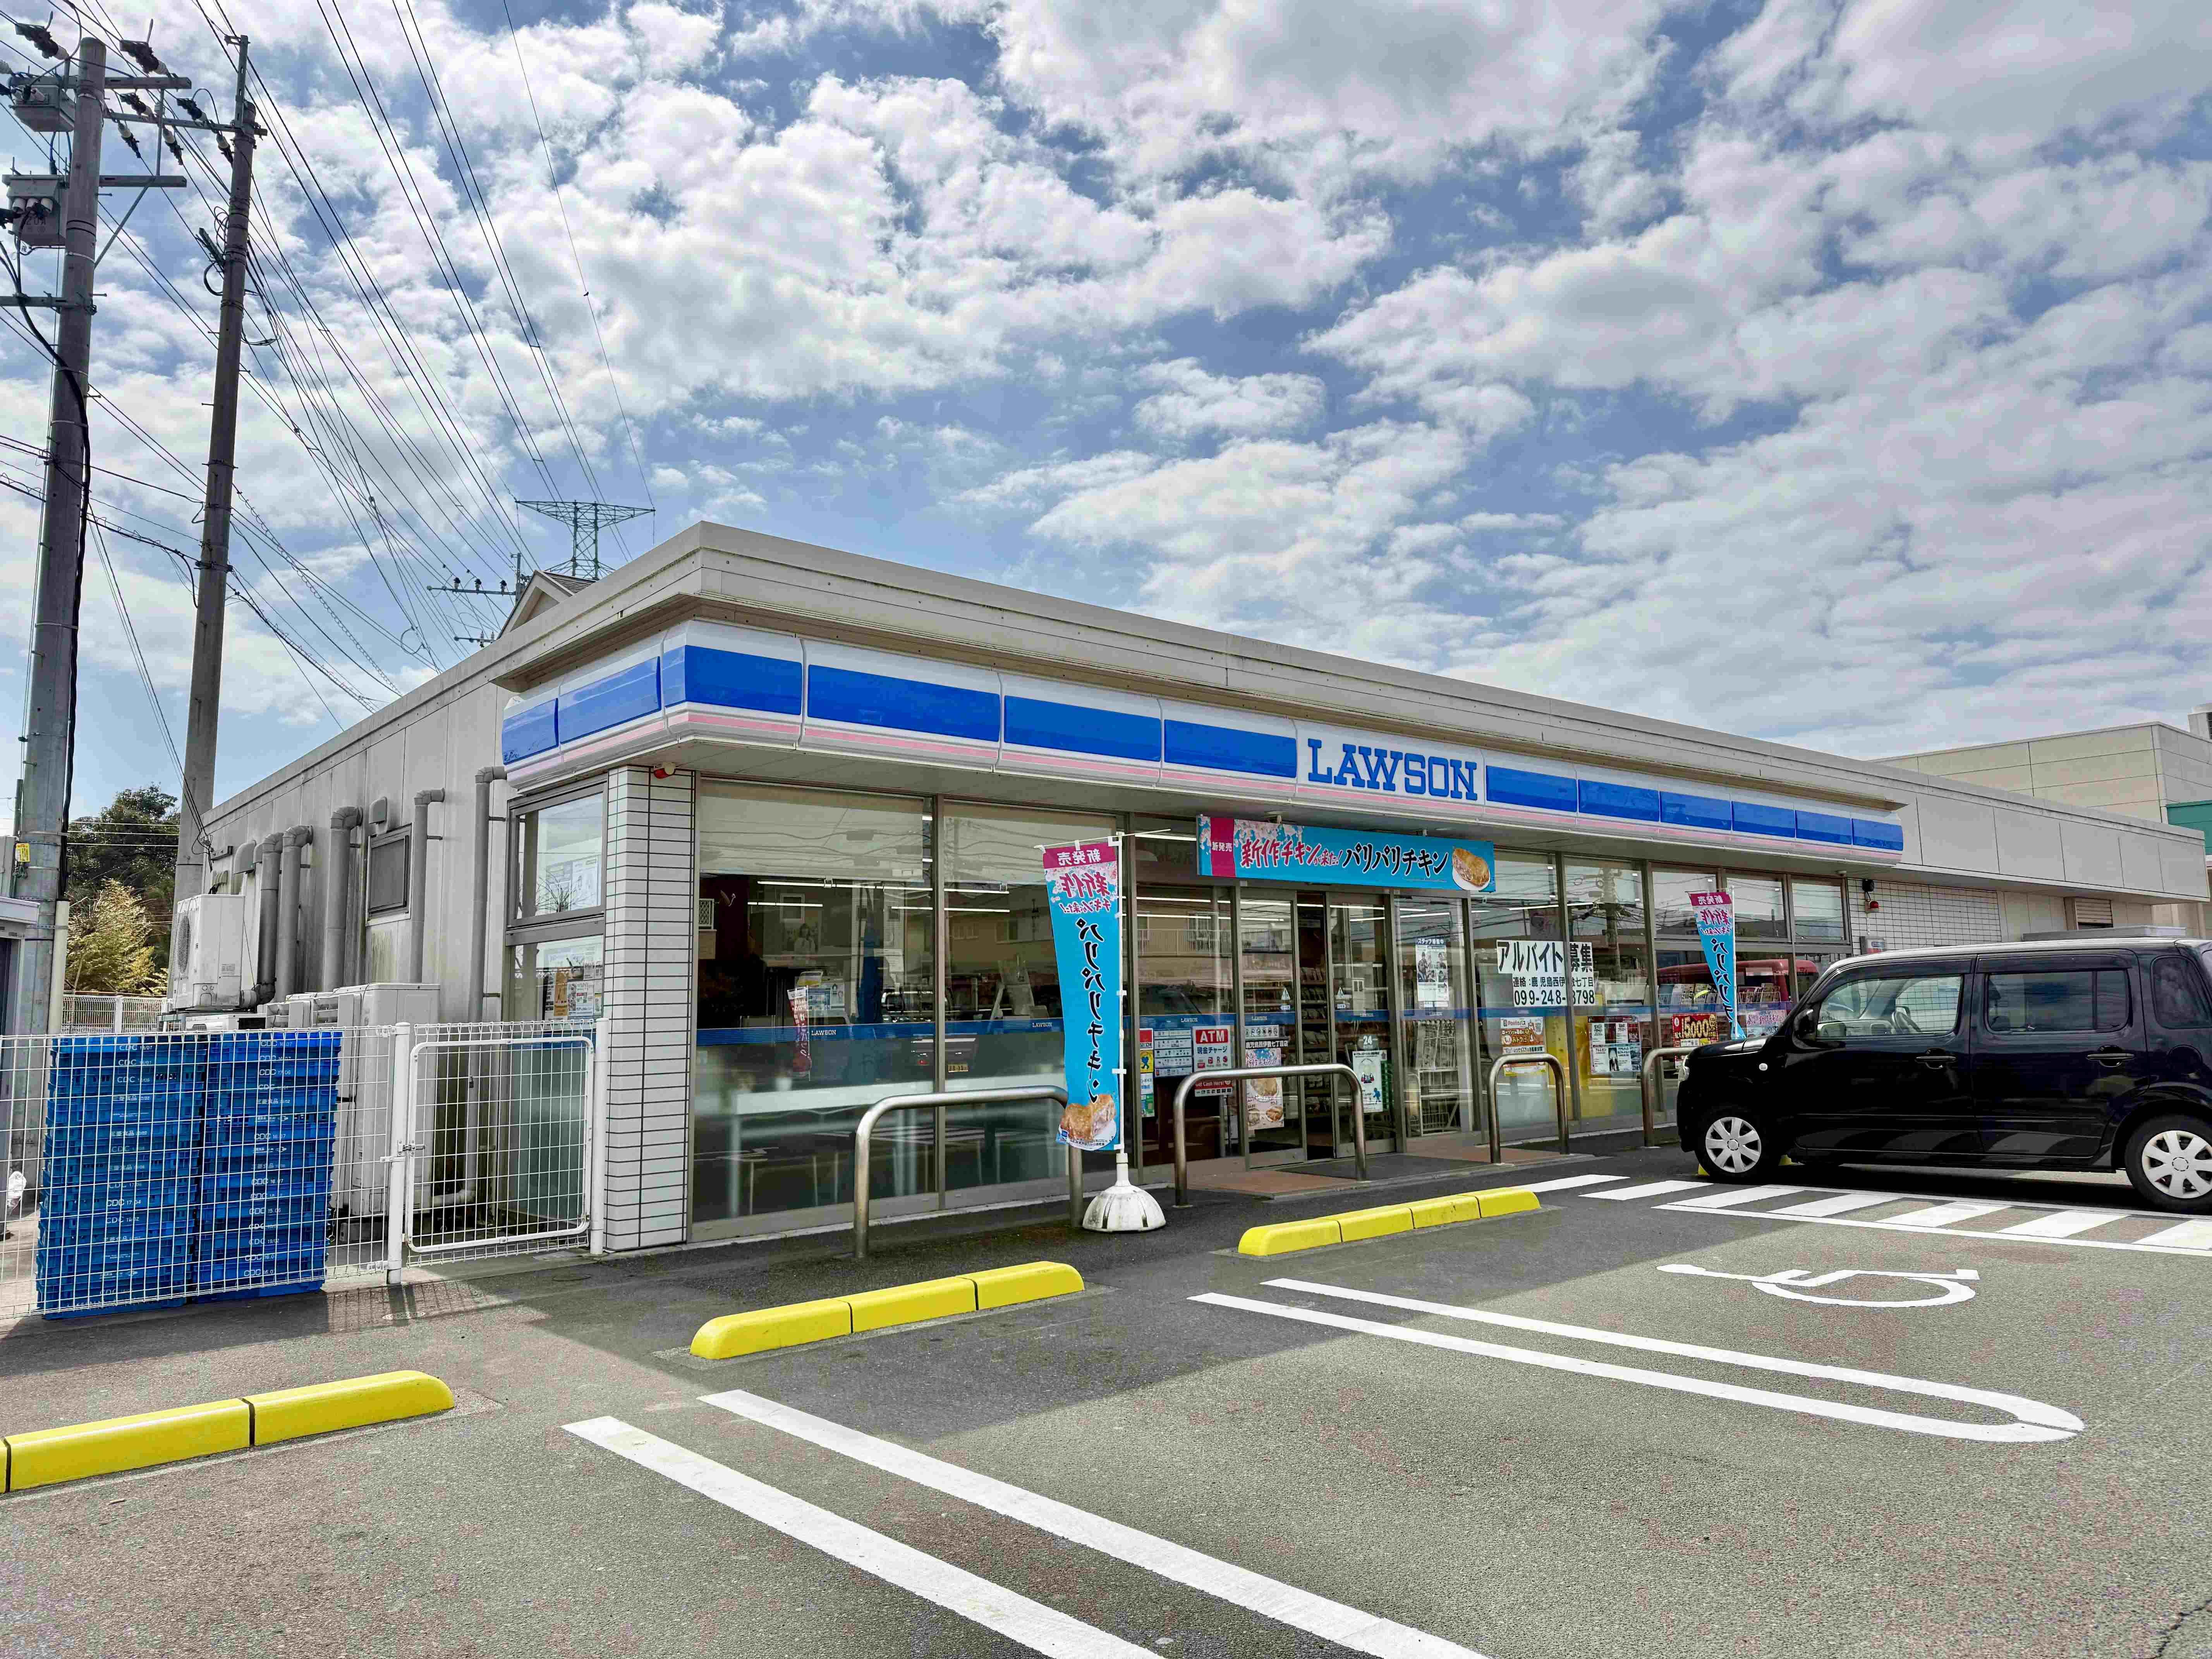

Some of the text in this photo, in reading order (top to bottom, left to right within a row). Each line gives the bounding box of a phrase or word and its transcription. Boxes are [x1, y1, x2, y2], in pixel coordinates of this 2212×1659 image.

[1308, 738, 1477, 801] LAWSON
[1211, 841, 1233, 852] 新発売
[1342, 842, 1449, 877] パリパリチキン
[1200, 1030, 1225, 1042] ATM
